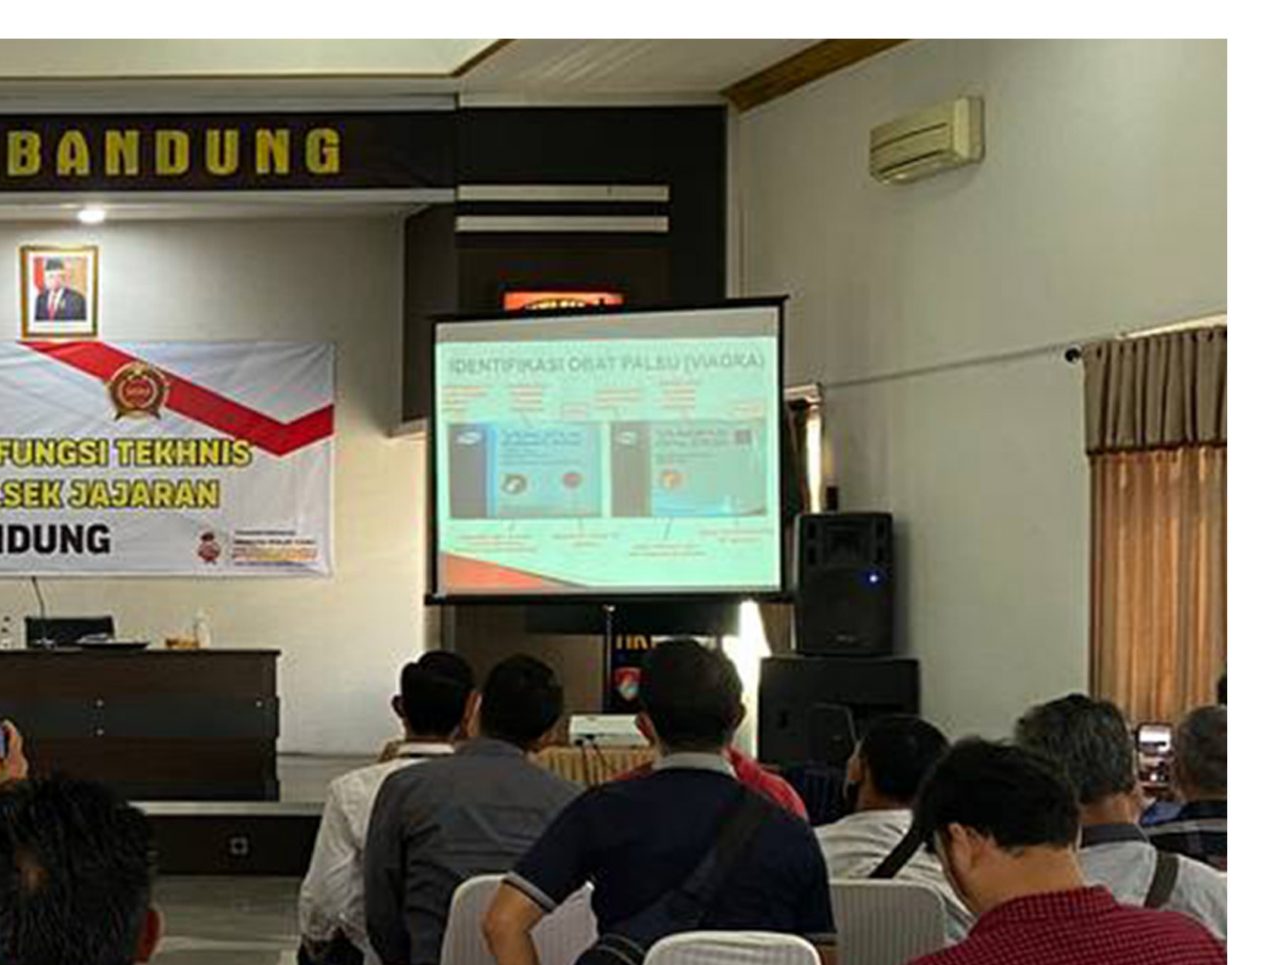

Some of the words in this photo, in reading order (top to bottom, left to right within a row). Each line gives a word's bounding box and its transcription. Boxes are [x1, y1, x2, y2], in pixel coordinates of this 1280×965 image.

[7, 128, 341, 177] BANDUNG
[114, 438, 253, 468] TEKHNIS
[69, 479, 220, 509] JAJARAN
